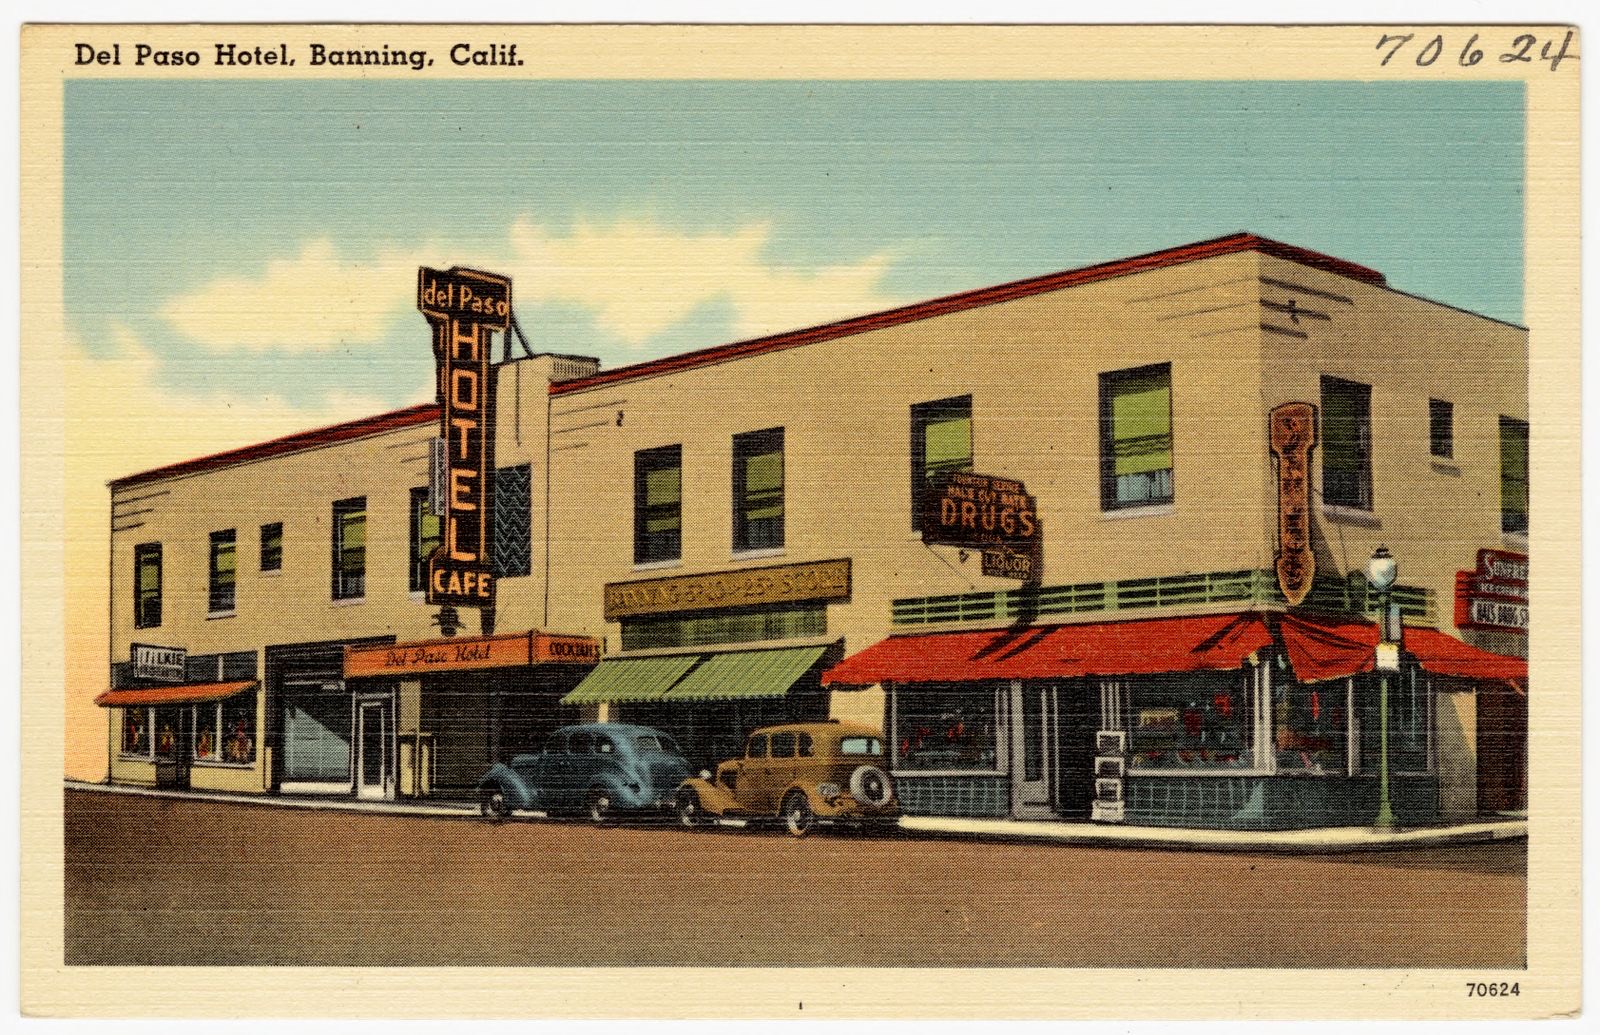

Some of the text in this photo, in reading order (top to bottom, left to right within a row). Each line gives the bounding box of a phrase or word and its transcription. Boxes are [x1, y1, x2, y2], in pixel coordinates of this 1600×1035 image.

[1376, 31, 1580, 72] 70624
[425, 279, 508, 316] del Paso
[451, 319, 479, 562] HOTEL
[941, 498, 1035, 538] DRUGS
[985, 554, 1031, 572] LIQUOR
[433, 569, 491, 597] CAFE
